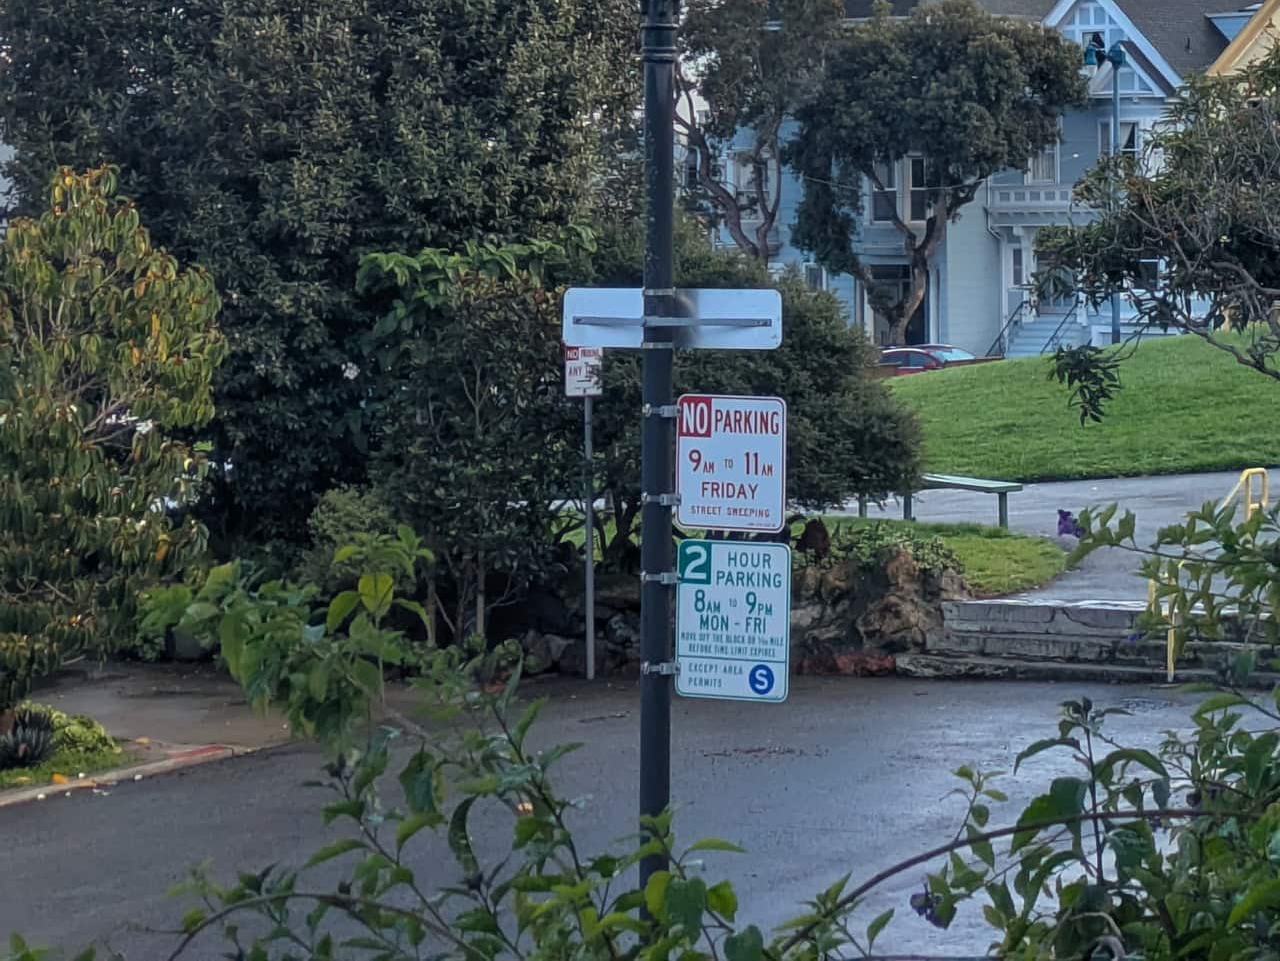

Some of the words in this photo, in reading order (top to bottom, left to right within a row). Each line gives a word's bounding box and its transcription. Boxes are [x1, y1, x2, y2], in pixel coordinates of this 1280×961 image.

[567, 350, 579, 359] NO
[569, 366, 582, 376] ANY
[682, 402, 708, 434] NO
[714, 409, 780, 435] PARKING
[688, 449, 715, 474] 9AM
[724, 458, 734, 469] TO
[744, 451, 773, 477] 11AM
[701, 481, 759, 500] FRIDAY
[690, 505, 722, 515] STREET
[726, 507, 770, 518] SWEEPING
[683, 545, 707, 580] 2
[727, 551, 772, 569] HOUR
[716, 570, 782, 588] PARKING
[694, 589, 721, 614] 8AM
[729, 598, 738, 608] TO
[745, 591, 773, 616] 9PM
[699, 614, 729, 632] MON
[745, 616, 767, 634] FRI
[681, 632, 697, 641] MOVE
[713, 634, 724, 643] THE
[725, 635, 745, 644] BLOCK
[770, 637, 784, 647] MILE
[688, 643, 713, 654] BEFORE
[714, 645, 729, 655] TIME
[731, 646, 748, 656] LIMIT
[688, 663, 718, 673] EXCEPT
[722, 665, 744, 675] AREA
[688, 677, 722, 688] PERMITS
[754, 669, 769, 690] S
